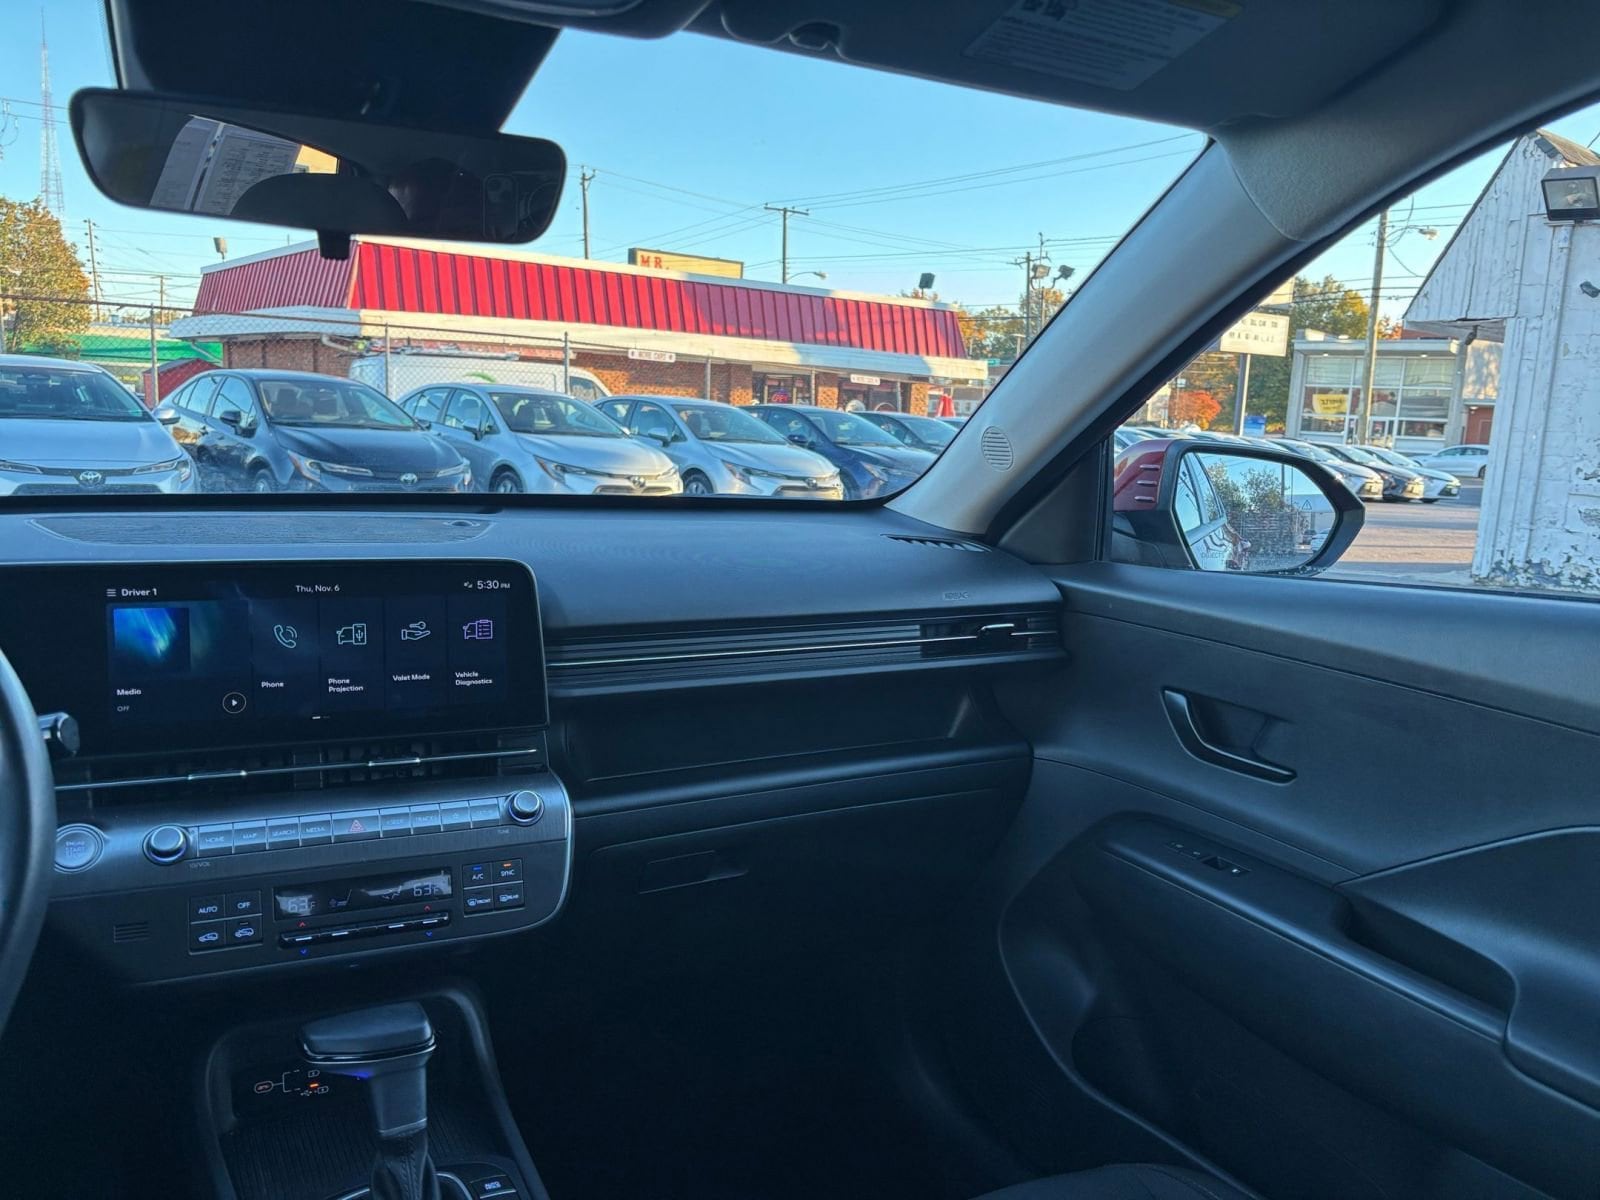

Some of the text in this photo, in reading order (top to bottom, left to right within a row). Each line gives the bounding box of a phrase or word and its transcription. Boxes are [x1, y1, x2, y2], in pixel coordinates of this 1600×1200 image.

[296, 585, 313, 593] Thu,
[334, 584, 340, 592] 6
[477, 580, 499, 590] 5:30
[121, 588, 150, 597] Driver
[393, 673, 430, 682] Valet Mode
[261, 681, 284, 689] Phone
[455, 678, 493, 686] Diagnostics
[116, 688, 142, 696] Media
[328, 685, 364, 693] Projection
[237, 901, 250, 909] OFF
[198, 905, 218, 914] AUTO
